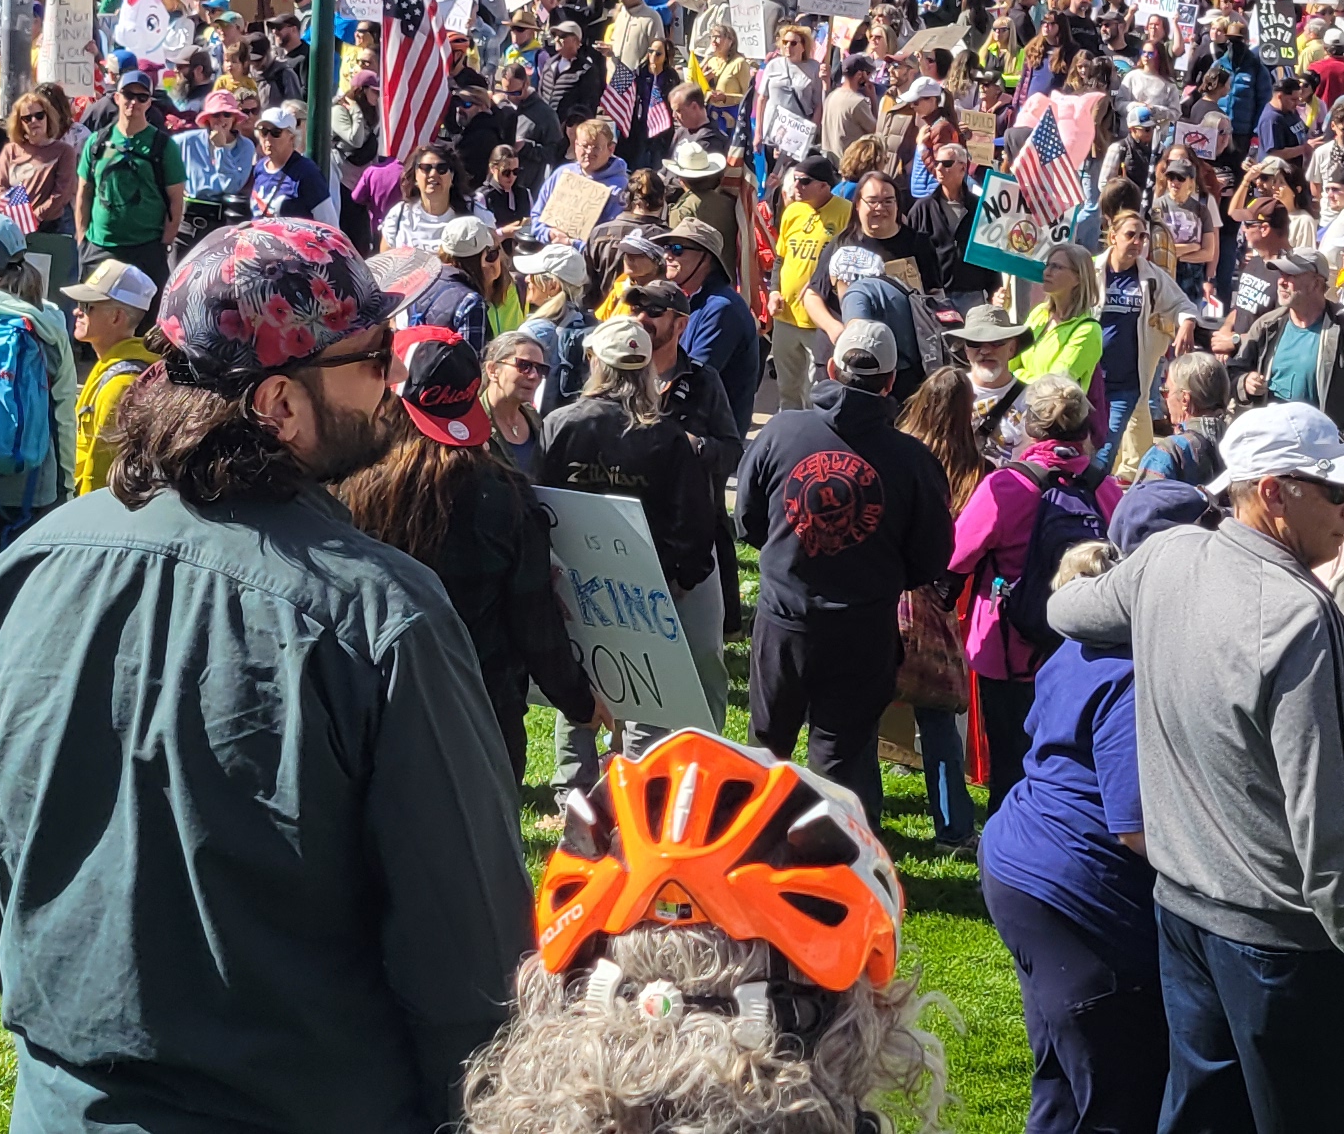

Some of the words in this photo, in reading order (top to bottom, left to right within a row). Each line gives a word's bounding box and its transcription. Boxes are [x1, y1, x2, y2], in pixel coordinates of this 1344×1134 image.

[1259, 0, 1276, 14] IT
[1260, 12, 1293, 28] ENDS
[1260, 27, 1292, 44] WITH
[1280, 46, 1296, 59] US
[775, 111, 788, 126] NO
[787, 119, 811, 136] KINGS
[982, 189, 1012, 224] NO
[791, 452, 877, 488] REGGIE'S
[584, 533, 601, 551] IS
[613, 538, 629, 556] A
[568, 568, 679, 643] KING
[568, 638, 663, 709] RON
